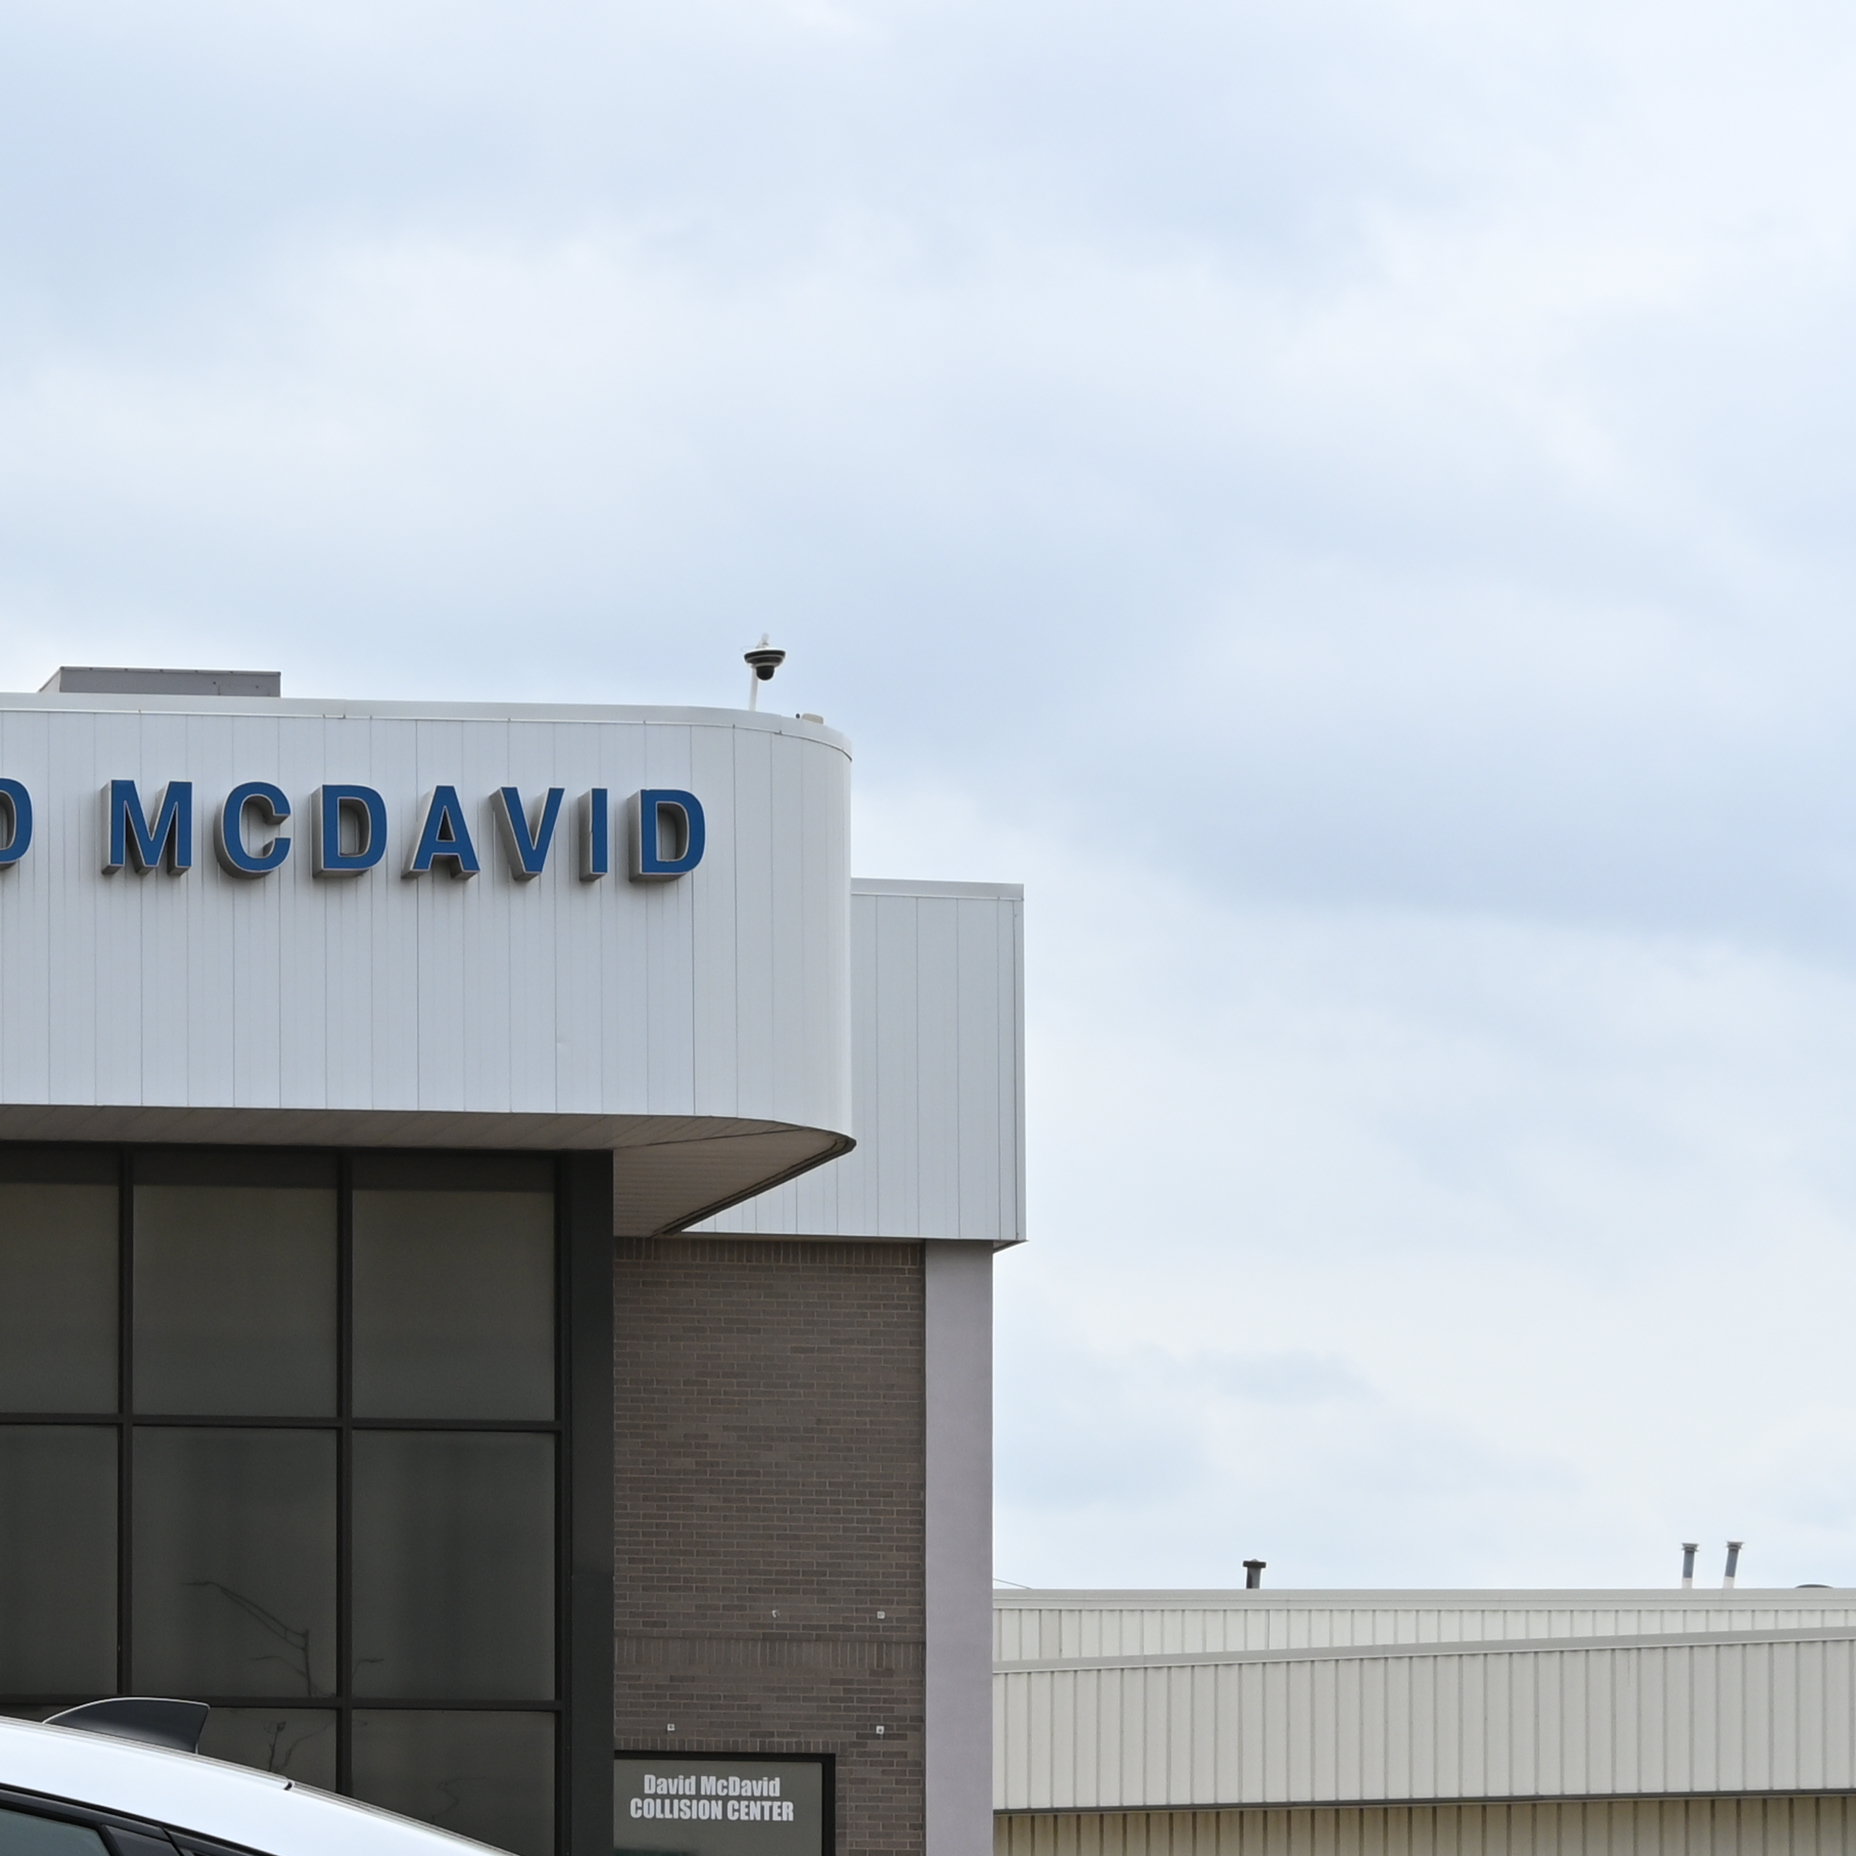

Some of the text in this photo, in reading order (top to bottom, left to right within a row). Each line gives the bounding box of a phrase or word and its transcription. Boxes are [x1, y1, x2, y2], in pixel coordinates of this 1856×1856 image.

[101, 779, 706, 882] MCDAVID
[644, 1774, 781, 1797] David McDavid
[630, 1797, 794, 1821] COLLISION CENTER
